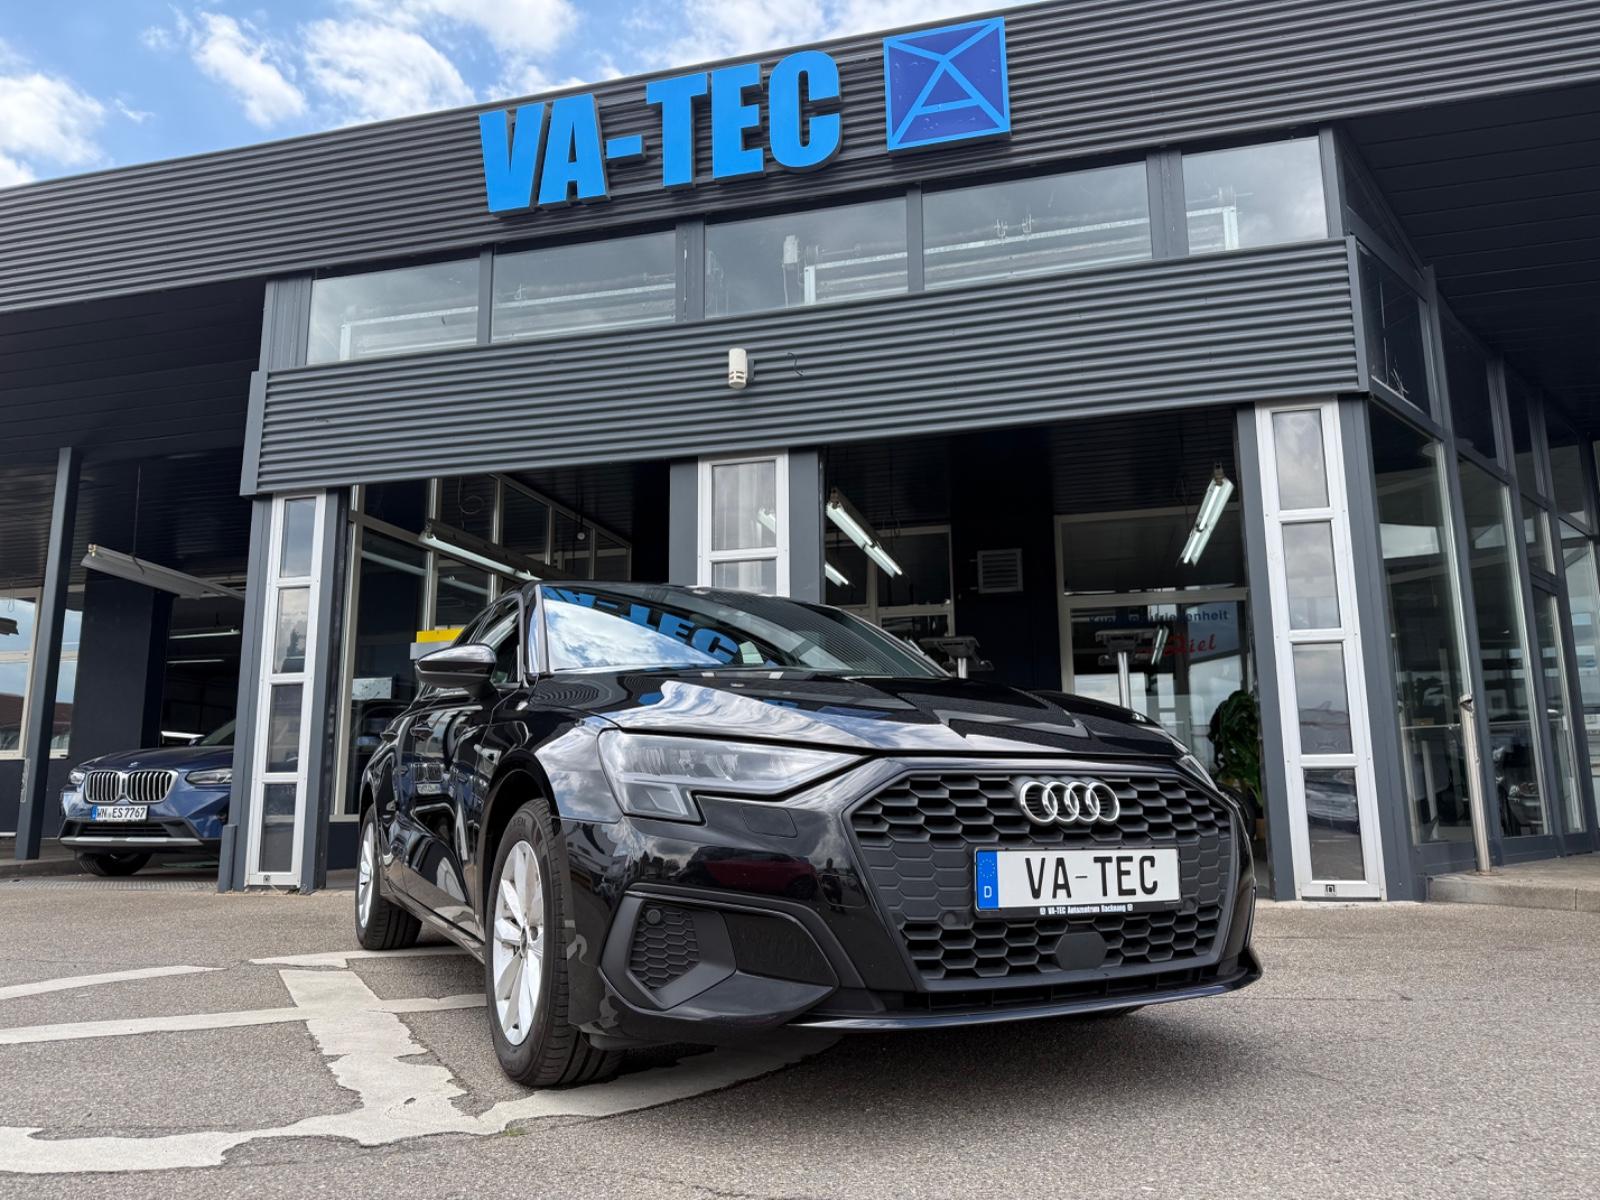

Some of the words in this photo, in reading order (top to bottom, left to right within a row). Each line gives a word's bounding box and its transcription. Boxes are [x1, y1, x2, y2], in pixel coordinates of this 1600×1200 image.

[478, 49, 842, 214] VA-TEC
[1088, 609, 1229, 625] Kunufrieenheit
[984, 885, 993, 898] D
[1025, 855, 1159, 900] VA-TEC
